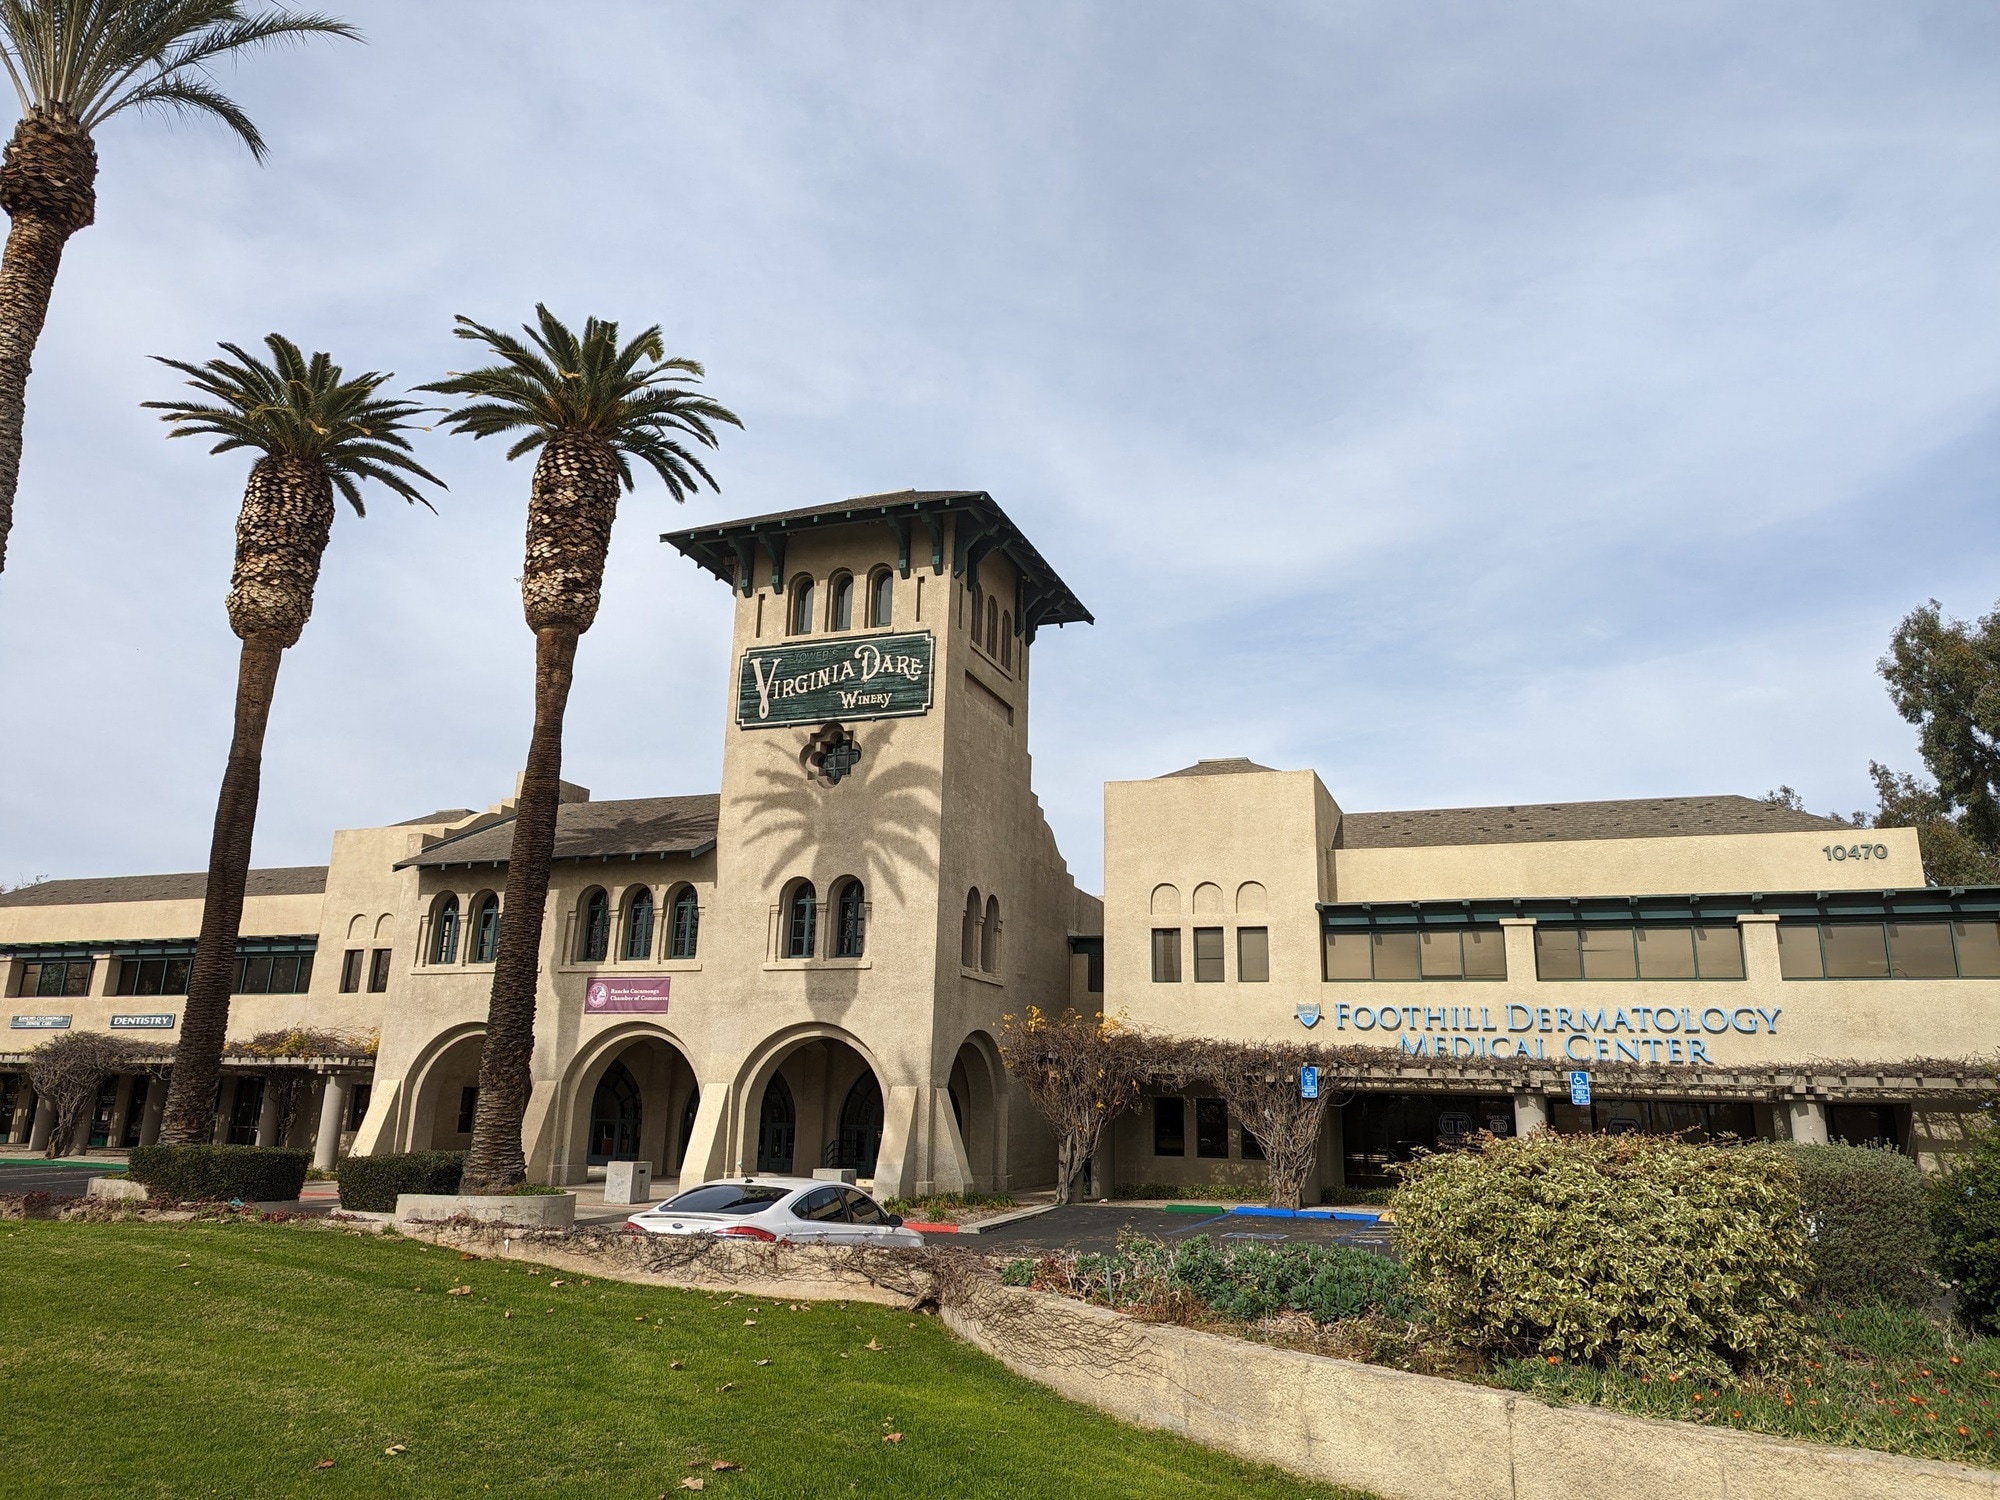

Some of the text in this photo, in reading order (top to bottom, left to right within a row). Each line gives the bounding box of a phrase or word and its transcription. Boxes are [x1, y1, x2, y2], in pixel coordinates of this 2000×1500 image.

[837, 689, 893, 709] WINERY
[1822, 843, 1888, 861] 10470
[113, 1016, 170, 1025] DENTISTRY
[1335, 1002, 1782, 1033] FOOTHILL DERMATOLOGY
[1564, 1033, 1714, 1064] CENTER
